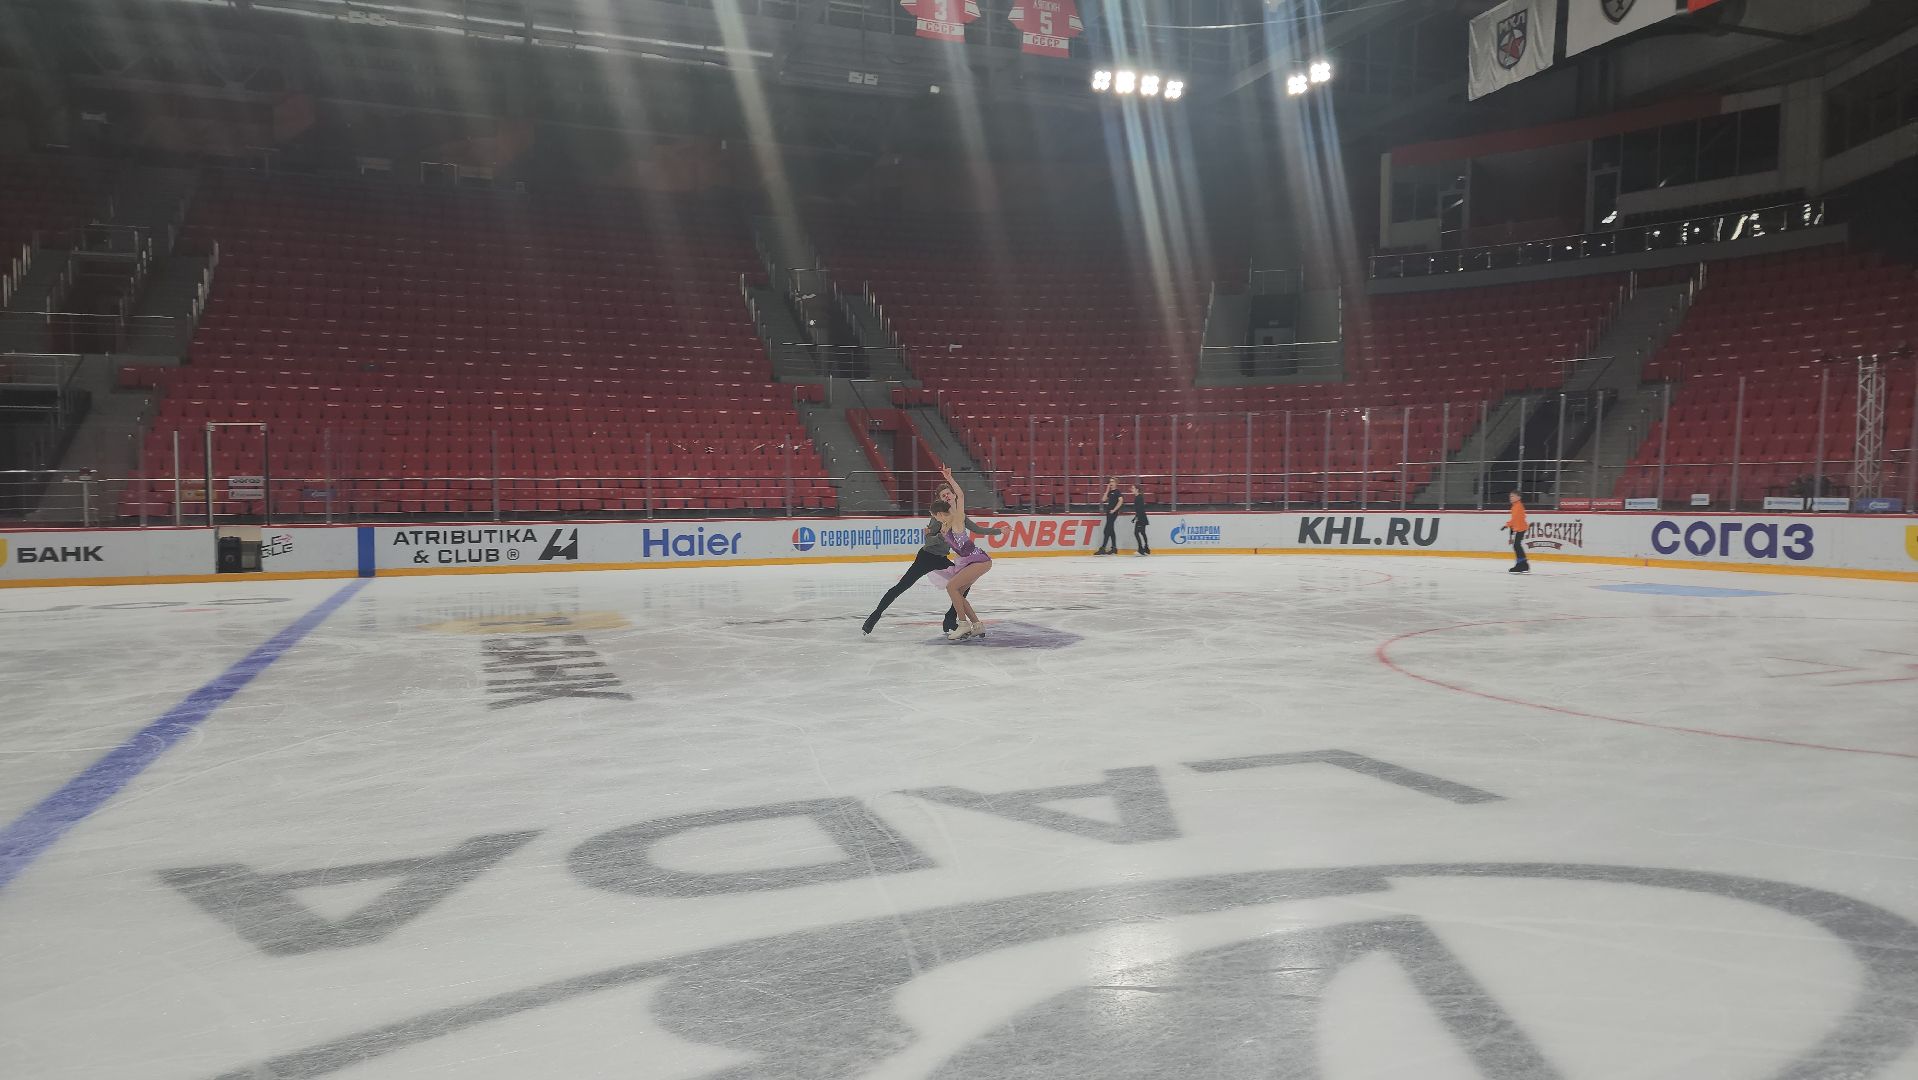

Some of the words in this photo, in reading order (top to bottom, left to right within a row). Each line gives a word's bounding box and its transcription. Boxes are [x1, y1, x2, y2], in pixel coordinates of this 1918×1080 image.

[926, 22, 955, 33] СССР
[1040, 11, 1053, 34] 5
[1033, 35, 1060, 47] СССР
[393, 529, 538, 546] ATRIBUTIKA
[970, 520, 1102, 548] FONBET
[1298, 517, 1440, 546] KHL.RU
[643, 526, 742, 558] Haier
[17, 545, 104, 563] БАНК
[413, 550, 429, 563] &
[438, 549, 500, 563] CLUB
[158, 749, 1504, 956] LADA
